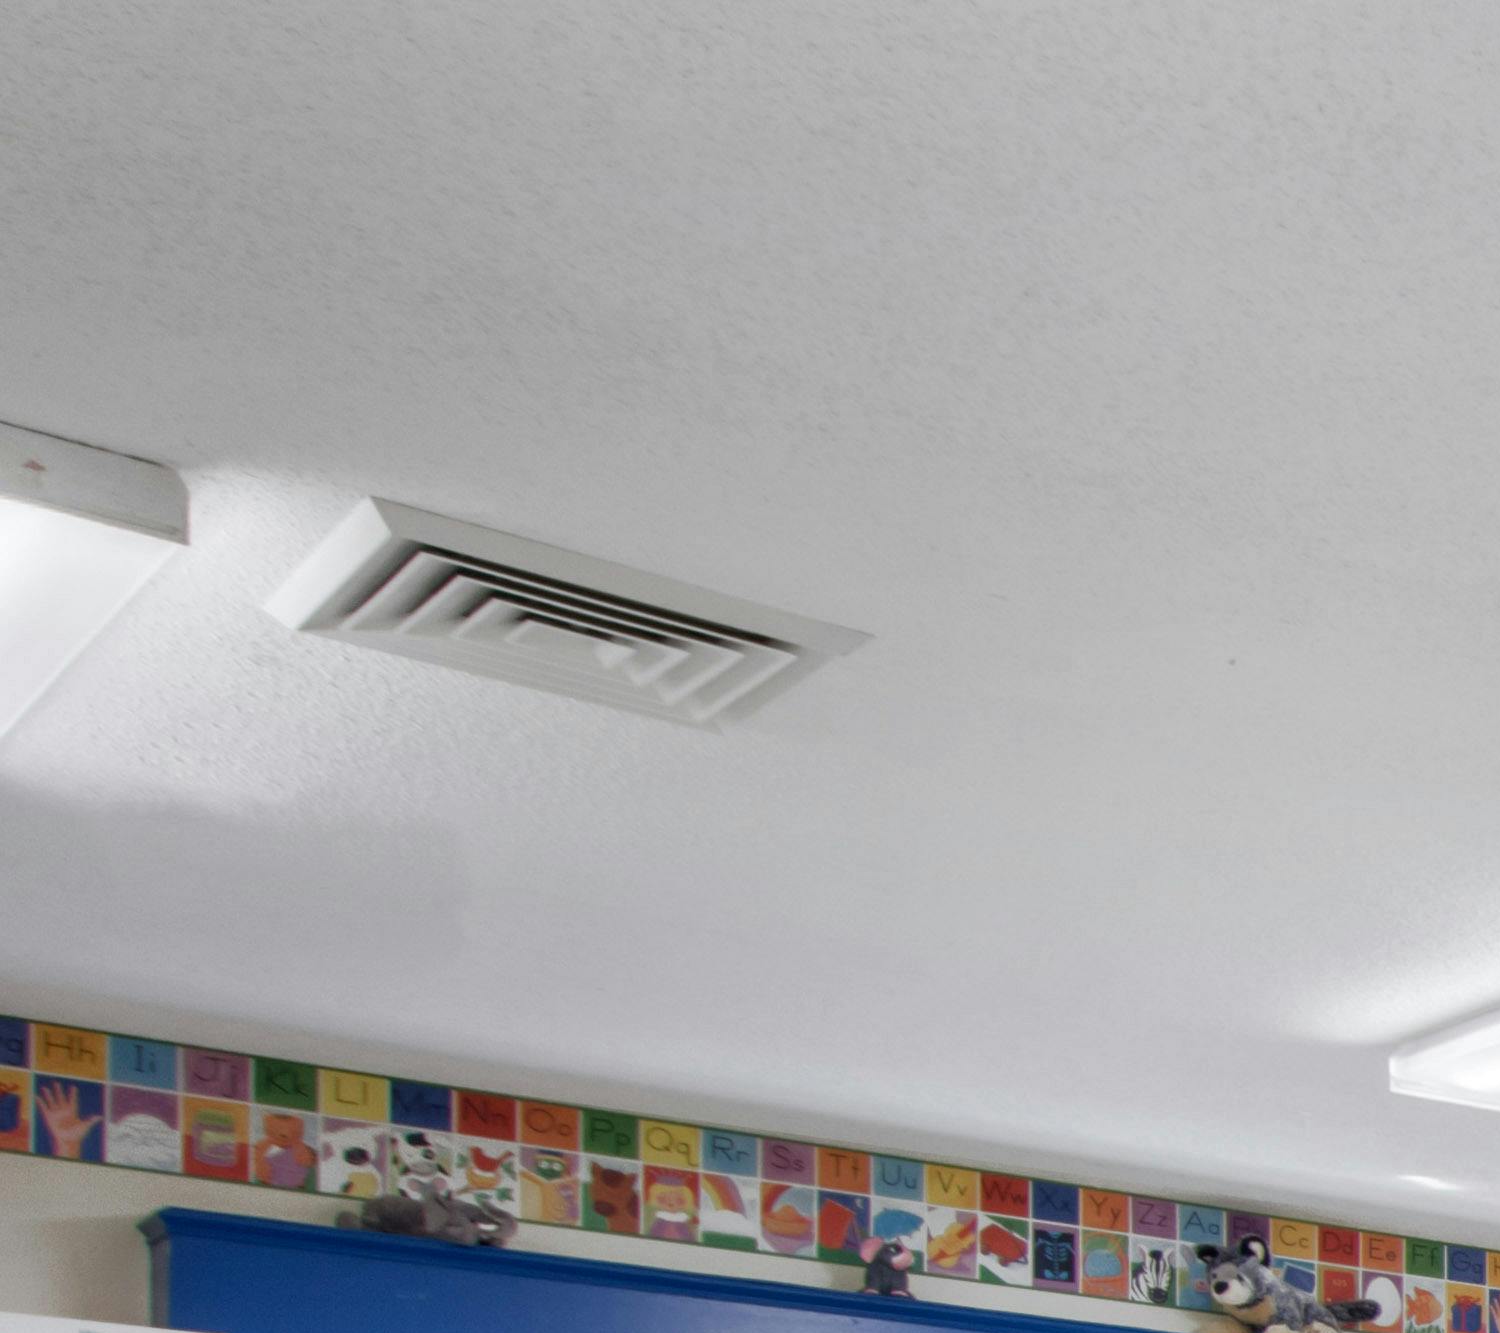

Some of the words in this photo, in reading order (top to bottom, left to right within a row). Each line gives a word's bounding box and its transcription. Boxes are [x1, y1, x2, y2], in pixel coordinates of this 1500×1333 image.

[525, 1108, 571, 1137] Oo
[590, 1118, 631, 1151] Pp
[645, 1127, 699, 1167] Qq
[711, 1136, 750, 1163] Rr
[771, 1144, 804, 1173] Ss
[832, 1154, 861, 1181] Tt
[880, 1158, 918, 1190] Uu
[937, 1171, 968, 1197] Vv
[983, 1177, 1025, 1206] Ww
[1089, 1196, 1121, 1228] Yy
[1138, 1203, 1168, 1227] Zz
[1184, 1210, 1220, 1238] Aa
[1278, 1225, 1308, 1250] Cc
[1323, 1229, 1353, 1257] Dd
[1368, 1237, 1396, 1261] Ee
[1411, 1243, 1439, 1265] Ff
